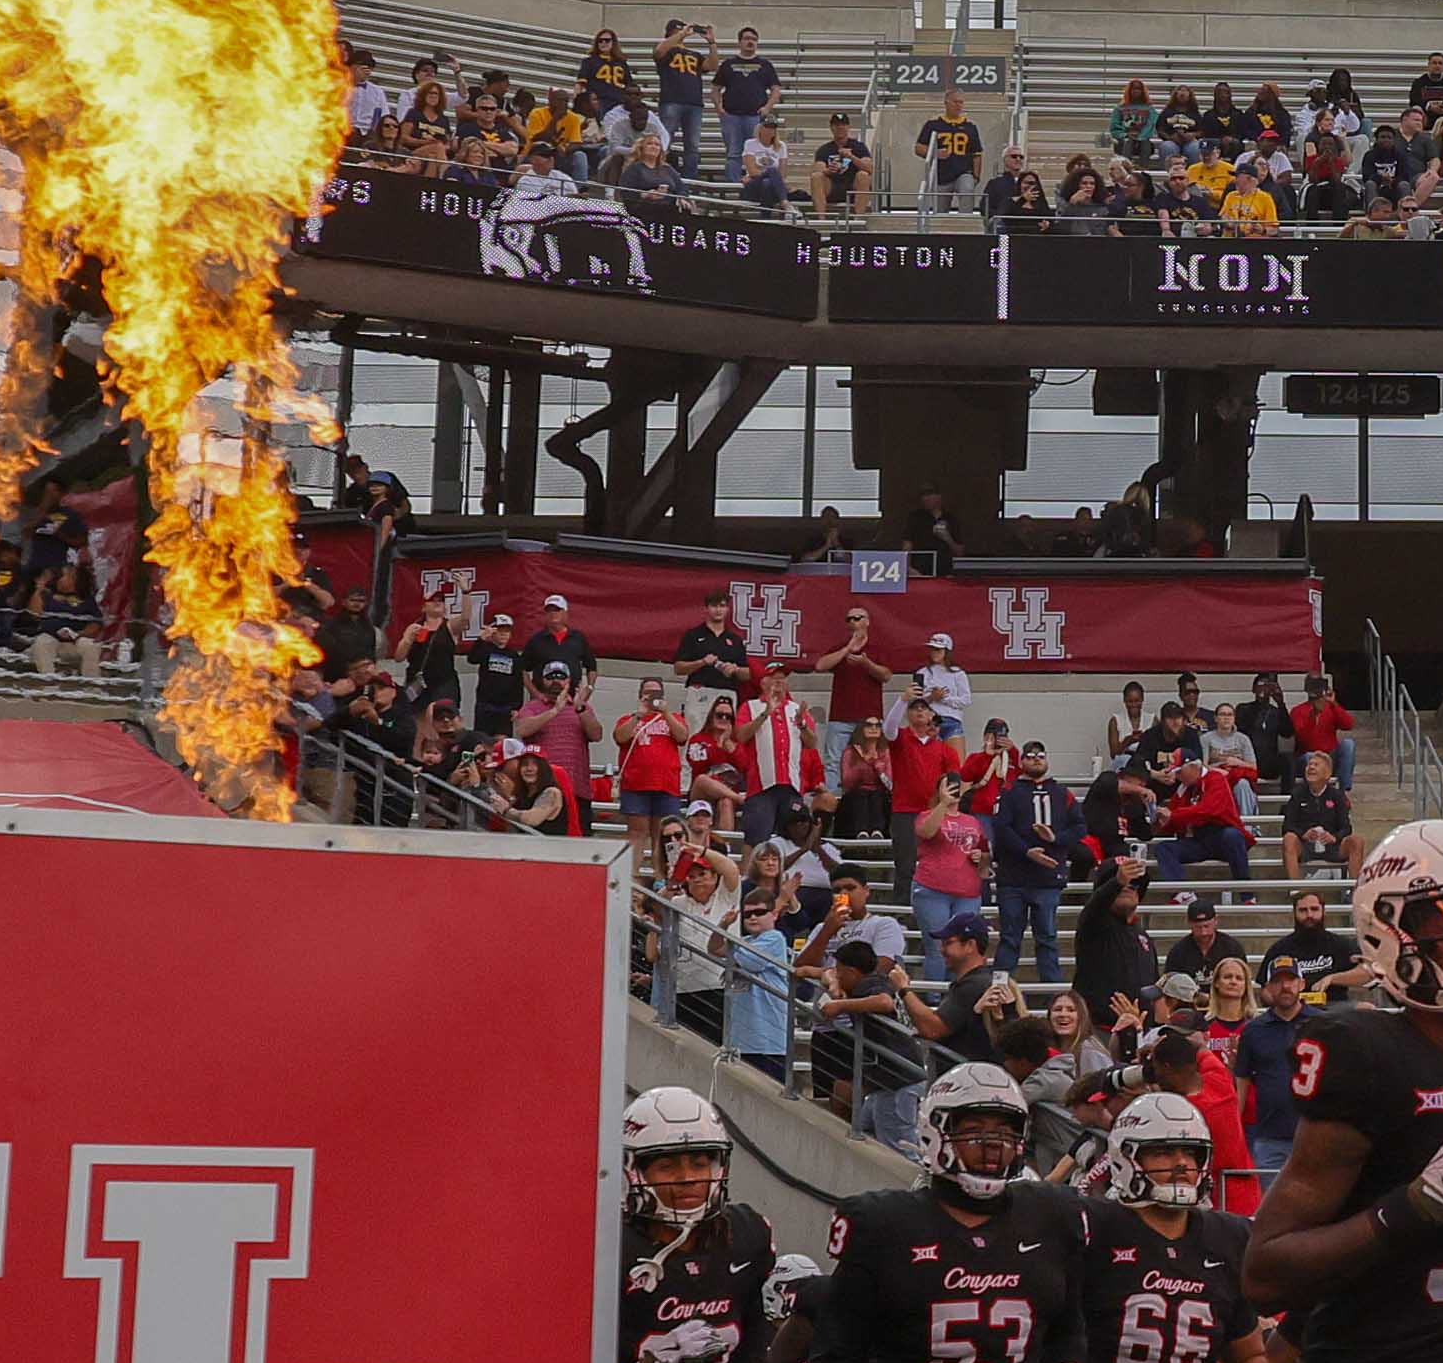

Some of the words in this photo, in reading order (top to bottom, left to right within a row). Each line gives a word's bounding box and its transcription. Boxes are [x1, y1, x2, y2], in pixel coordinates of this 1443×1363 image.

[896, 64, 940, 86] 224
[956, 64, 999, 86] 225
[937, 131, 969, 155] 38
[647, 221, 751, 256] UGARS
[796, 241, 955, 269] HOUSTON
[858, 560, 901, 583] 124
[988, 586, 1066, 660] UH
[1032, 793, 1052, 825] 11
[1291, 1039, 1326, 1101] 3
[944, 1267, 1021, 1292] Cougars
[1142, 1269, 1207, 1296] Cougars
